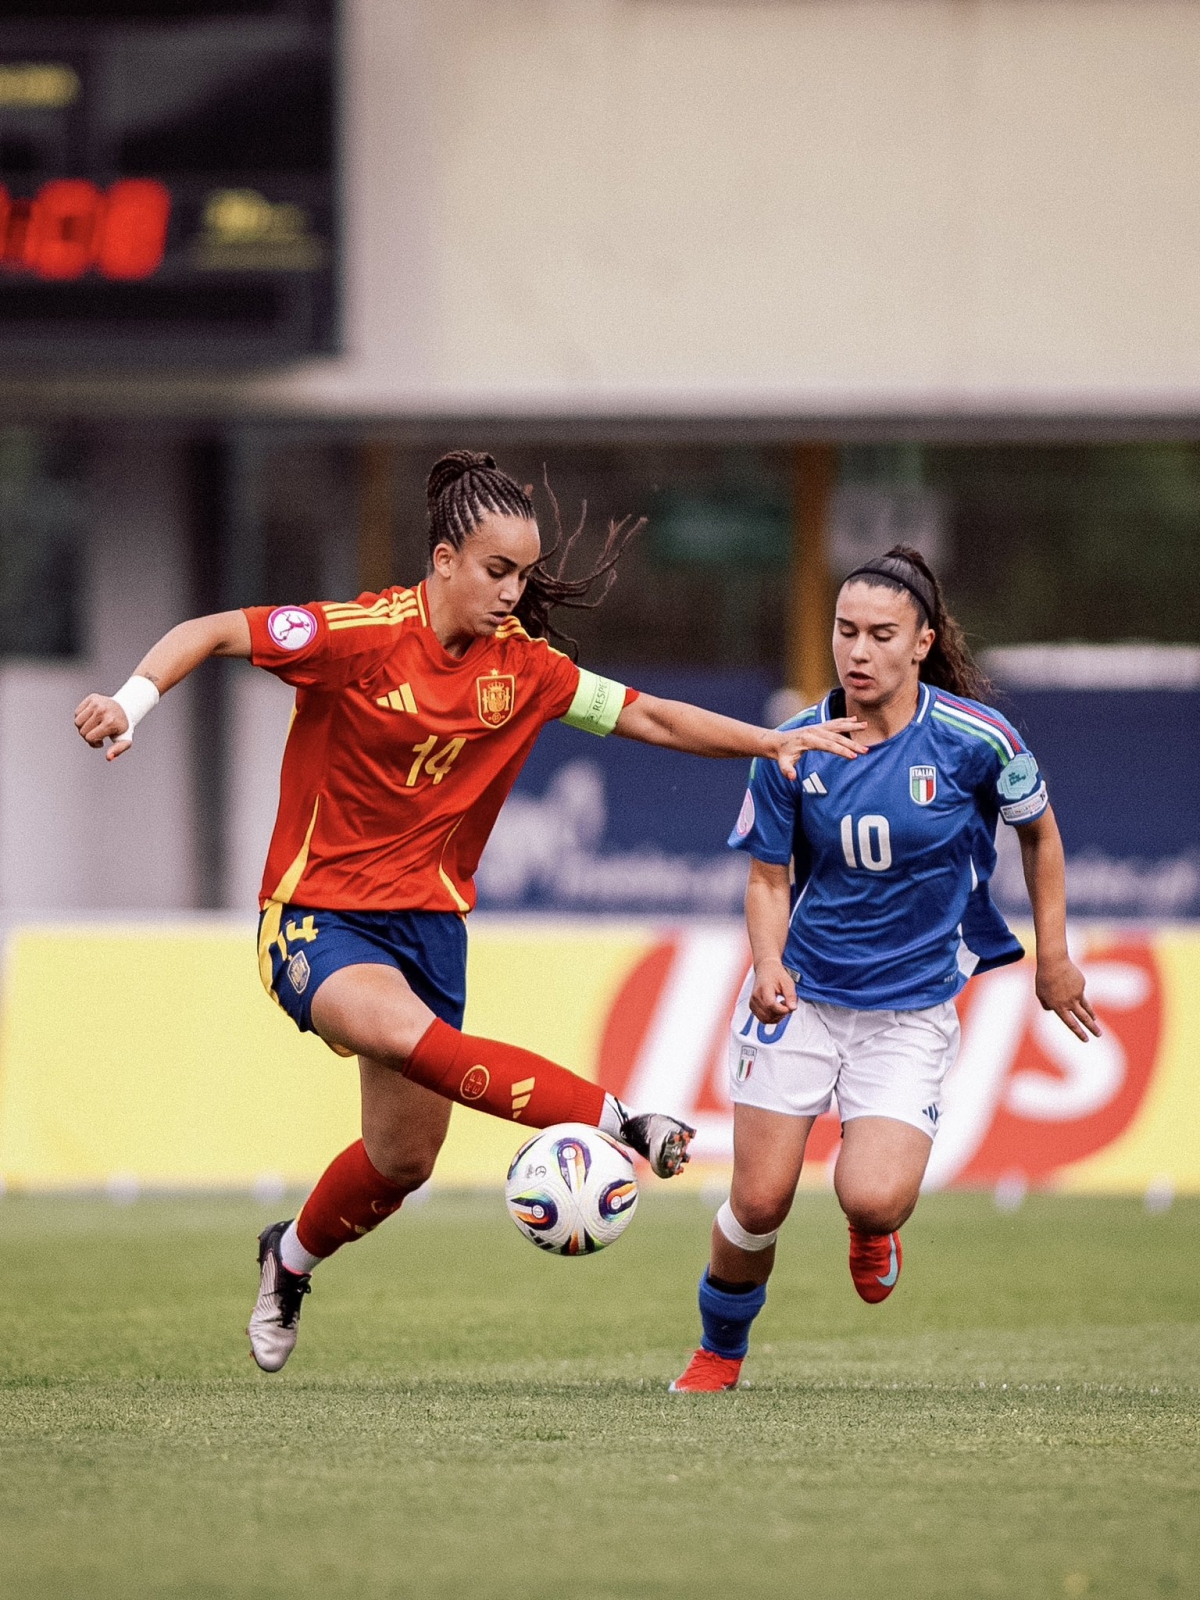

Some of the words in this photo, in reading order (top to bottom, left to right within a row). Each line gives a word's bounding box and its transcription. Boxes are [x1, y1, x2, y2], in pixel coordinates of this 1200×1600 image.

[592, 675, 608, 712] RESPEC
[406, 734, 467, 787] 14
[912, 768, 934, 777] ITALIA
[840, 814, 892, 871] 10
